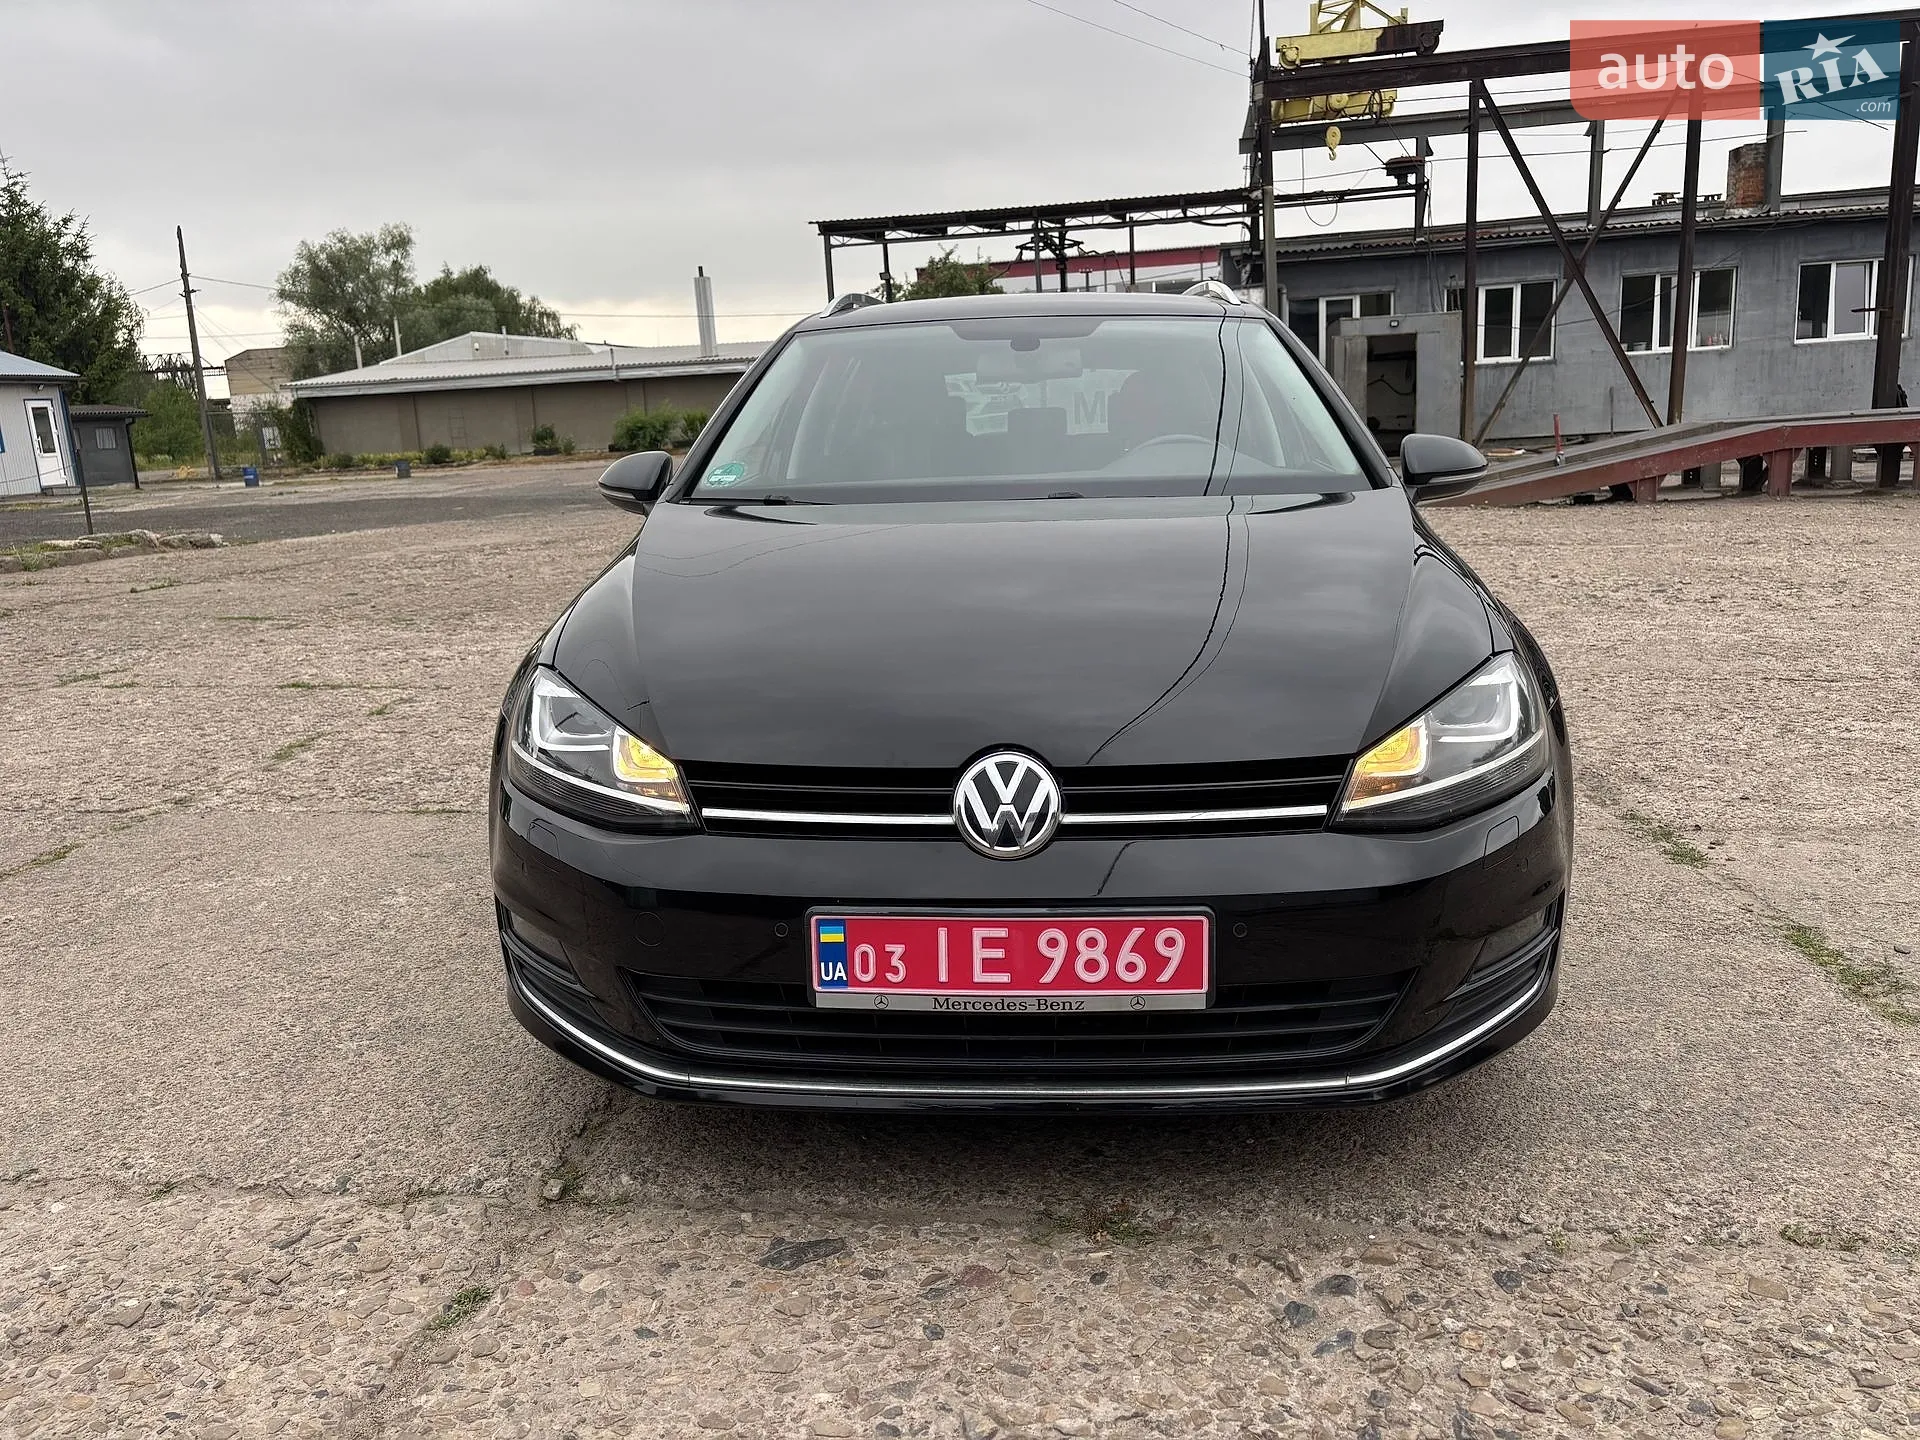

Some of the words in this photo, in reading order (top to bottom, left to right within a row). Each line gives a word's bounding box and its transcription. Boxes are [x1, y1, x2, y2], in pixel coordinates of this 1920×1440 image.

[958, 756, 1054, 854] VW
[820, 961, 848, 981] UA
[853, 943, 907, 984] 03
[1037, 927, 1186, 984] 9869
[932, 996, 1086, 1012] Mercedes-Benz
